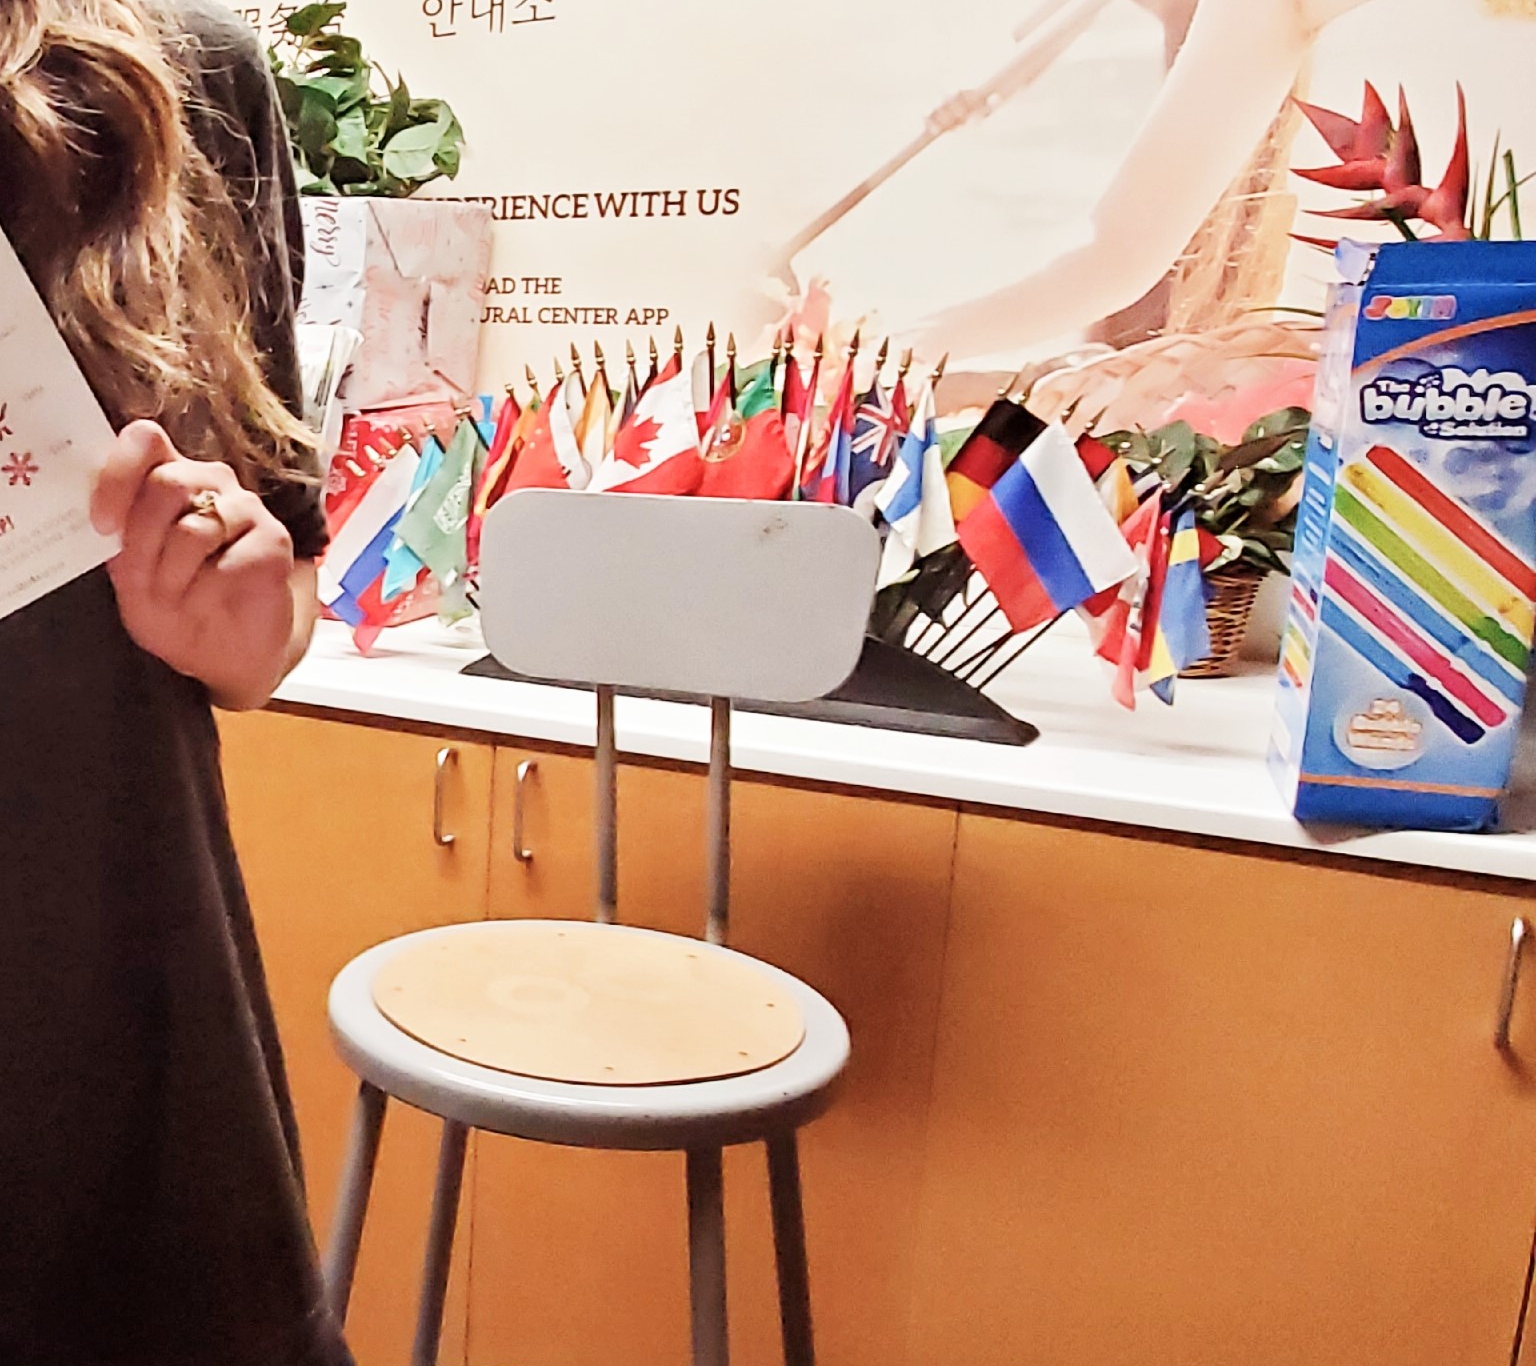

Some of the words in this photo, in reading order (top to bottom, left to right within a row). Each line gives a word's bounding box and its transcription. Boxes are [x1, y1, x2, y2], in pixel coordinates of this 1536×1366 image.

[594, 190, 687, 218] WITH
[696, 188, 740, 216] US
[521, 277, 562, 295] THE
[538, 307, 619, 325] CENTER
[624, 307, 670, 326] APP
[1363, 386, 1528, 422] bubble
